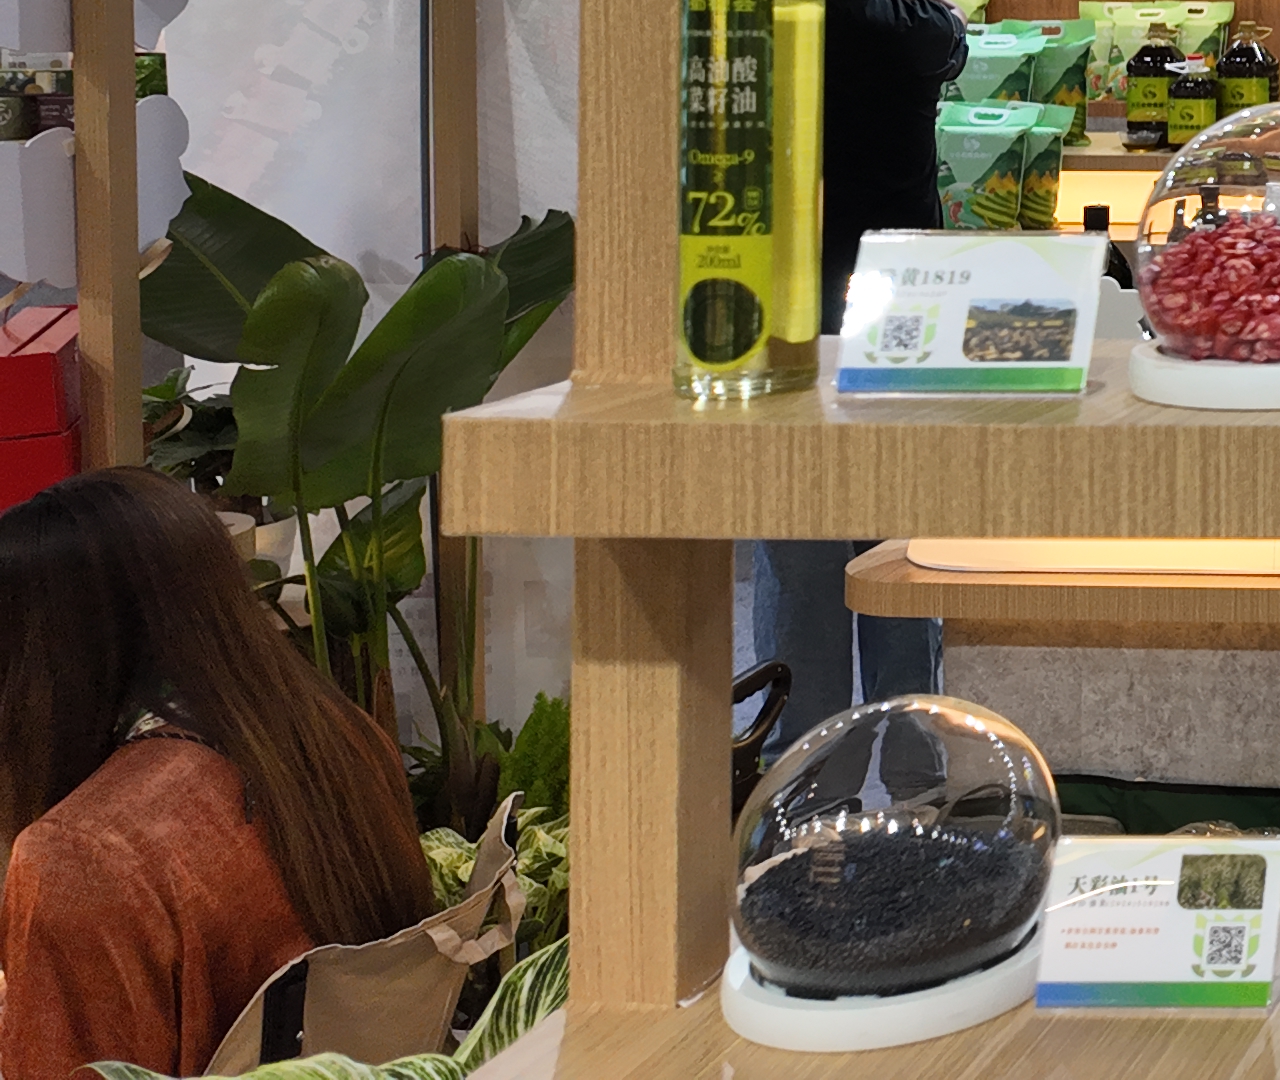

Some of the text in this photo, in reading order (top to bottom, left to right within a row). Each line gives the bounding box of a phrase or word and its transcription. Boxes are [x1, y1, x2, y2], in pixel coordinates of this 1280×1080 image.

[688, 55, 758, 84] 高油酸
[688, 149, 755, 168] Omega-9
[686, 191, 766, 235] 72%
